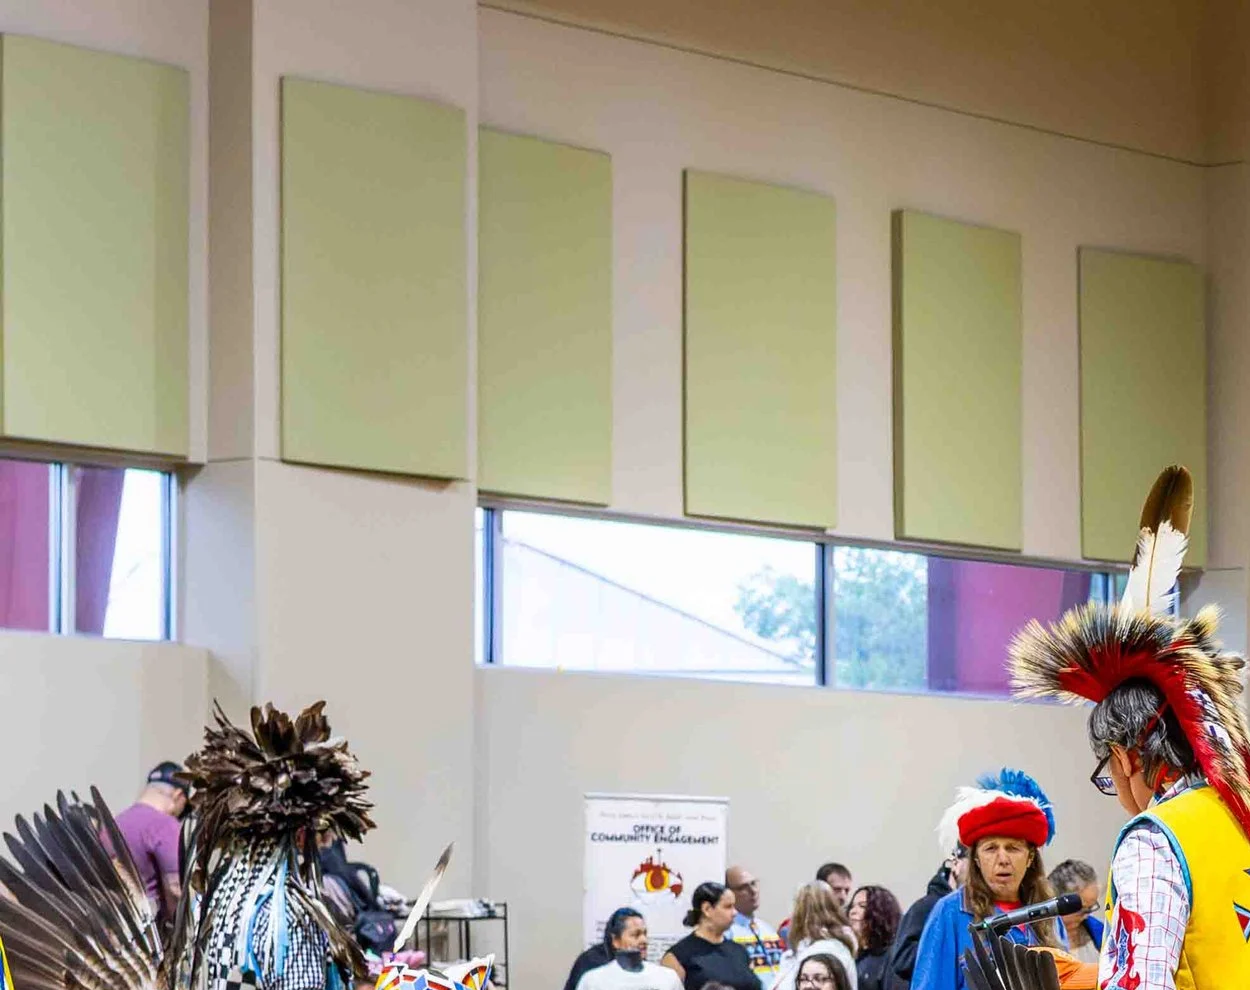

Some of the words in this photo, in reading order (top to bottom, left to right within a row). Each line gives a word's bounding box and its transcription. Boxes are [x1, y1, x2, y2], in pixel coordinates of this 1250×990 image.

[633, 824, 665, 834] OFFICE
[668, 825, 681, 834] OF
[591, 832, 651, 843] COMMUNITY
[654, 832, 719, 844] ENGAGEMENT
